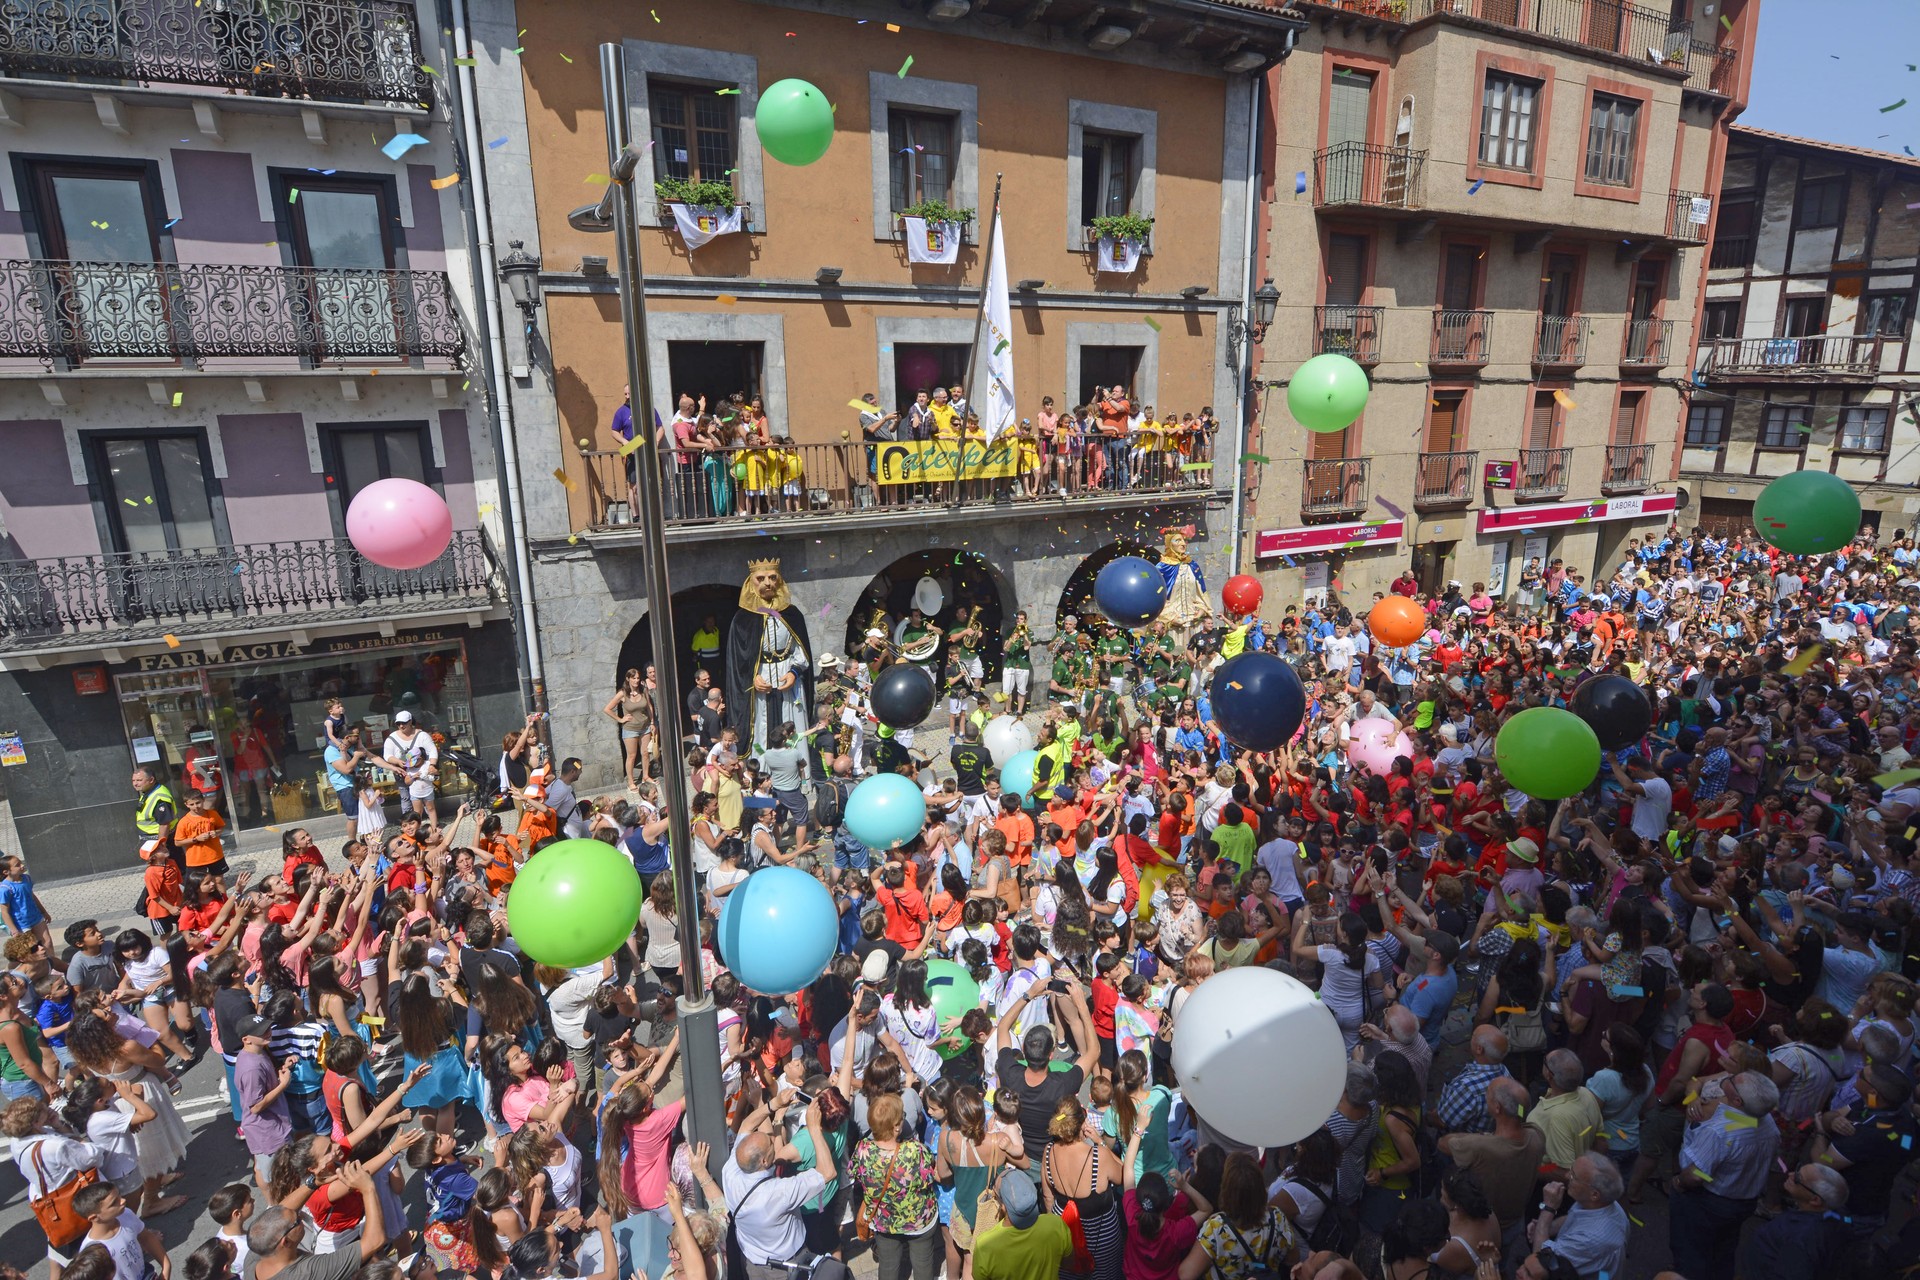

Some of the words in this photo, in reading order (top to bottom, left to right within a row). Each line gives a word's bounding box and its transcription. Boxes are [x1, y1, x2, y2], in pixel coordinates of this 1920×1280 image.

[1611, 501, 1639, 510] LABORAL
[1353, 527, 1377, 536] LABORAL
[930, 536, 939, 544] 22
[329, 643, 354, 652] LDO.
[358, 635, 418, 648] FERNANDO
[425, 632, 444, 640] GIL
[139, 642, 303, 671] FARMACIA
